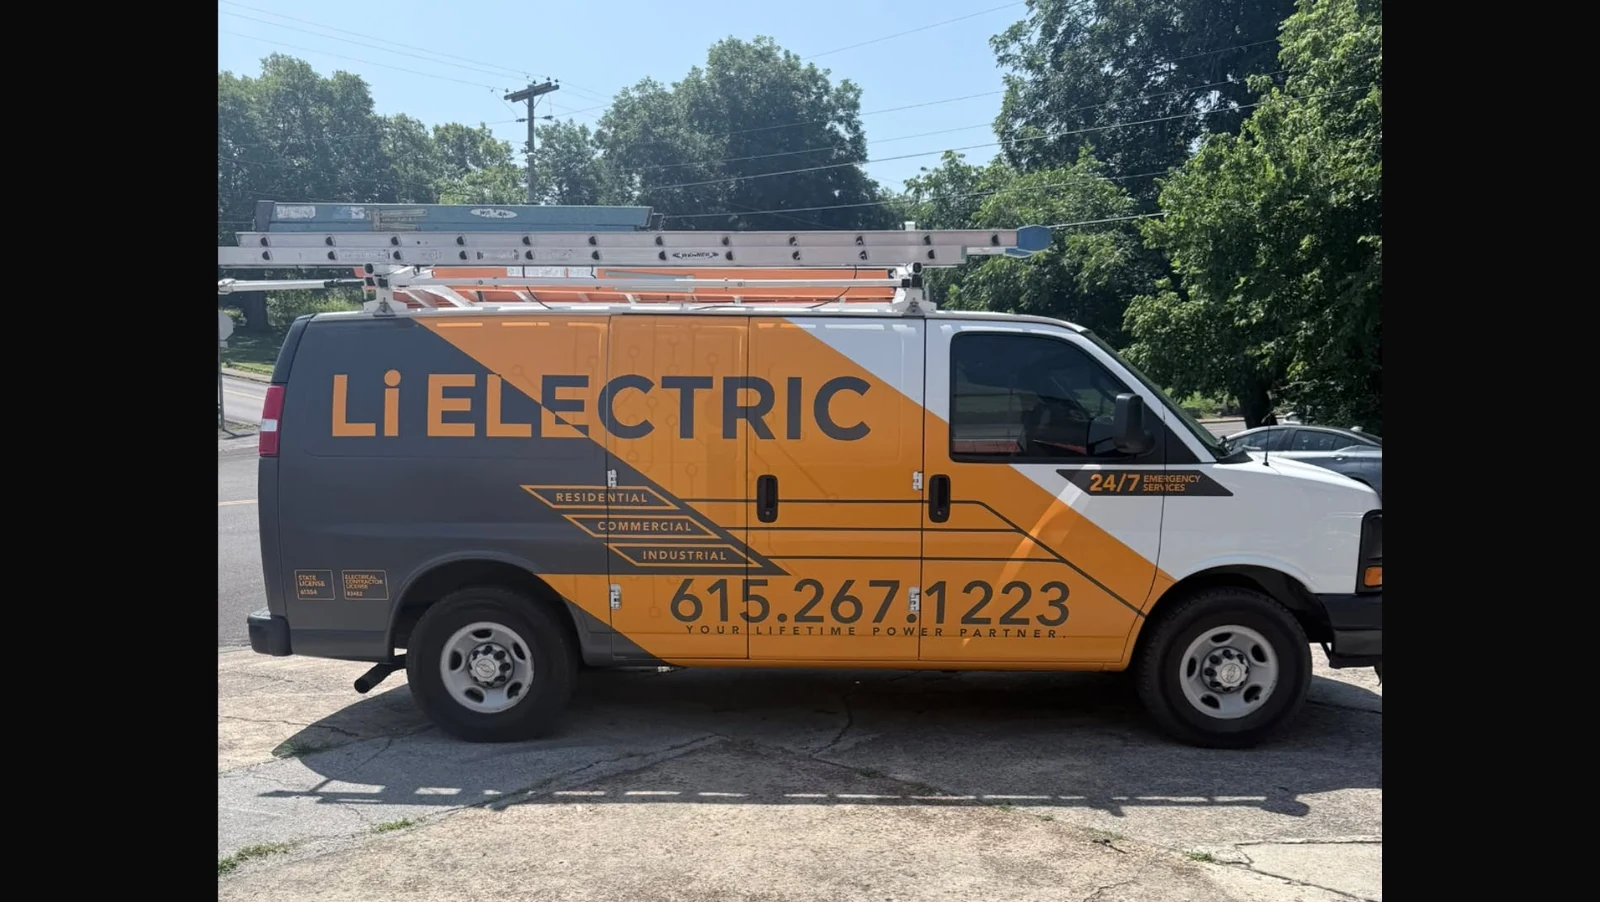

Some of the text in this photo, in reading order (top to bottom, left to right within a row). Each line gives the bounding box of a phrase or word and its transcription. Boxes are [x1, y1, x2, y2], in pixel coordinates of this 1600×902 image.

[332, 369, 872, 441] Li ELECTRIC
[1090, 473, 1141, 493] 24/7
[1143, 474, 1201, 483] EMERGENCY
[1143, 483, 1186, 492] SERVICES
[556, 492, 648, 503] RESIDENTIAL
[597, 521, 692, 532] COMMERCIAL
[643, 550, 727, 561] INDUSTRIAL
[670, 578, 1071, 627] 615.267.1223
[686, 625, 1068, 640] YOUR LIFETIME POWER PARTNER.
